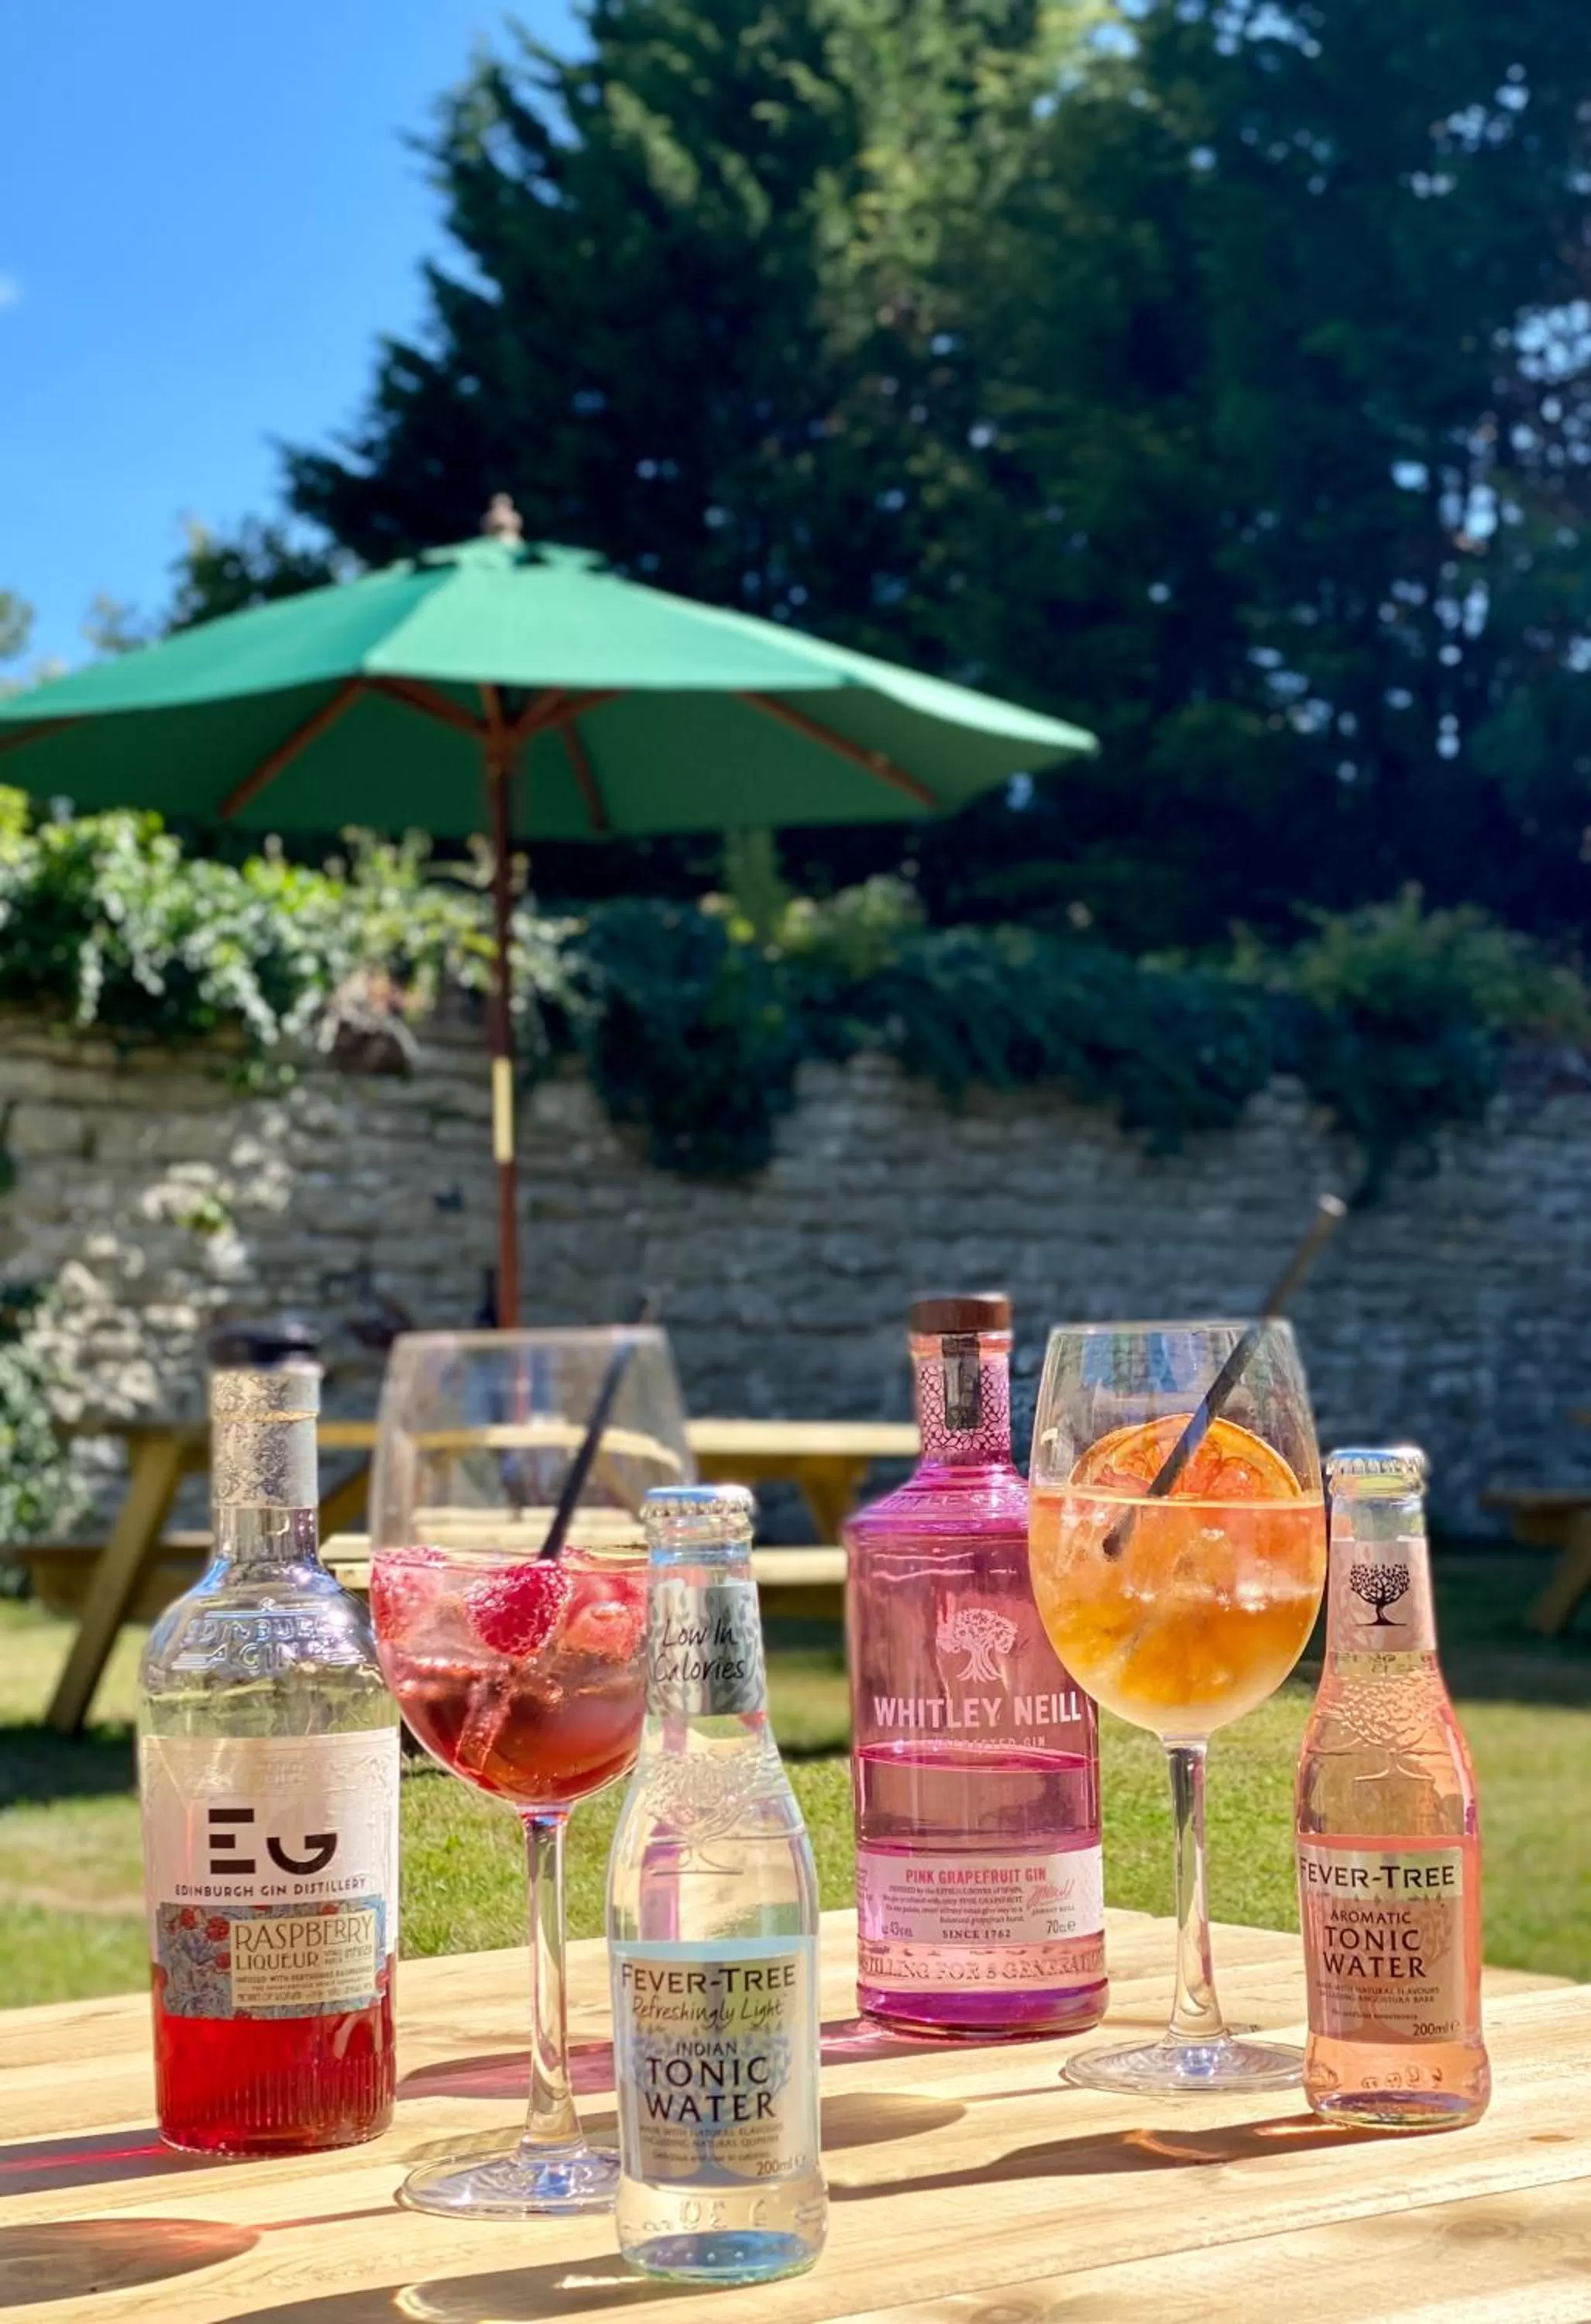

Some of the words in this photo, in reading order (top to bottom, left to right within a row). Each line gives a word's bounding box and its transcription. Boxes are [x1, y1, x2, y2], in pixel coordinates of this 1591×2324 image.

[663, 1619, 708, 1647] Low
[714, 1618, 737, 1646] In
[653, 1652, 746, 1682] Calories
[873, 1697, 1002, 1728] WHITLEY
[1013, 1691, 1082, 1726] NEILL
[208, 1807, 338, 1875] EG
[175, 1883, 254, 1897] EDINBURGH
[260, 1884, 287, 1896] GIN
[294, 1877, 366, 1896] DISTILLERY
[905, 1868, 933, 1884] PINK
[938, 1868, 1021, 1885] GRAPEFRUIT
[1025, 1867, 1046, 1882] GIN
[1299, 1856, 1455, 1889] FEVER-TREE
[1330, 1909, 1412, 1924] AROMATIC
[235, 1913, 373, 1953] RASPBERRY
[942, 1929, 980, 1939] SINCE
[1325, 1925, 1421, 1951] TONIC
[235, 1951, 319, 1971] LIQUEUR
[1322, 1951, 1427, 1978] WATER
[620, 1963, 796, 1994] FEVER-TREE
[632, 1996, 735, 2030] Refreshingly
[741, 1996, 784, 2027] Light
[1412, 2022, 1449, 2037] 200ml
[675, 2041, 737, 2057] INDIAN
[645, 2056, 769, 2088] TONIC
[644, 2091, 776, 2123] WATER
